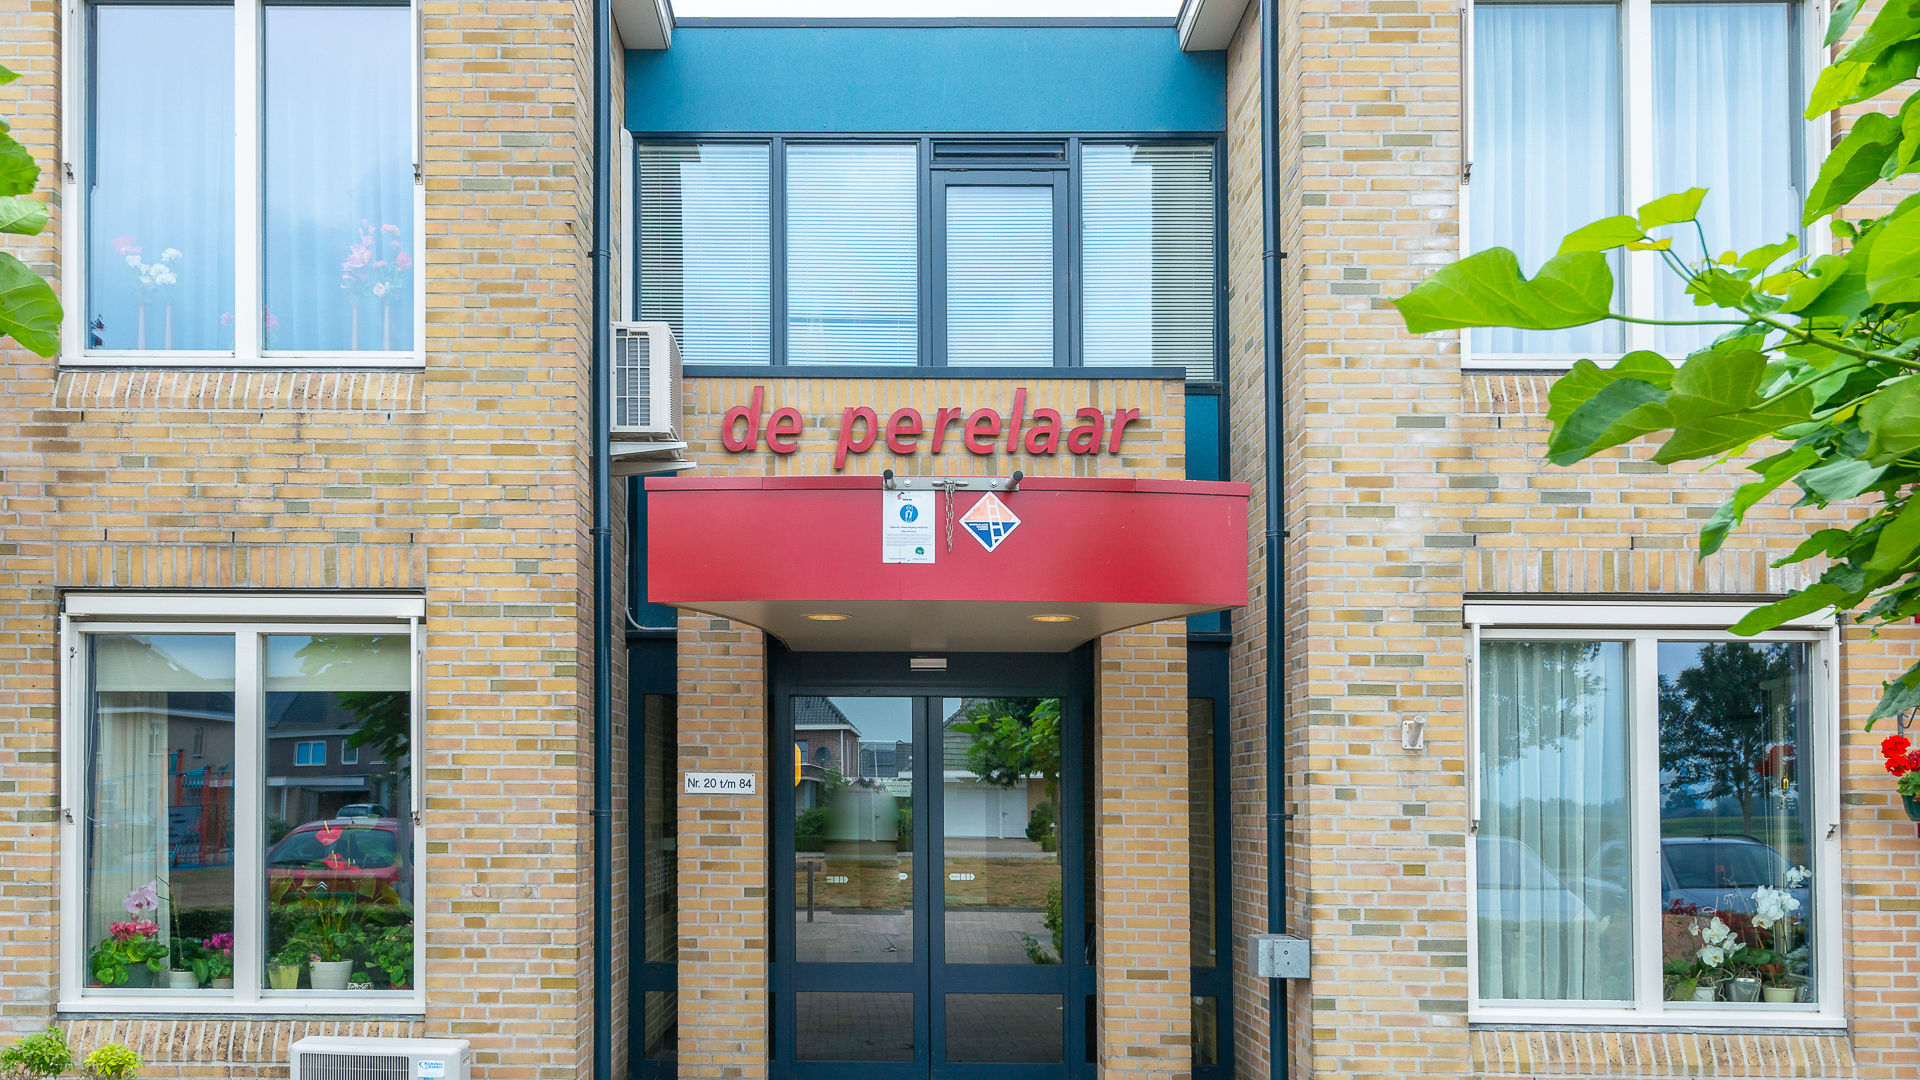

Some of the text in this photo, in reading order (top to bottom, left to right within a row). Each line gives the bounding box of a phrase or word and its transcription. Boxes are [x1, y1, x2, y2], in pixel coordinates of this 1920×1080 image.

[721, 385, 1140, 469] de perelaar
[687, 777, 752, 789] Nr. 20 t/m 84
